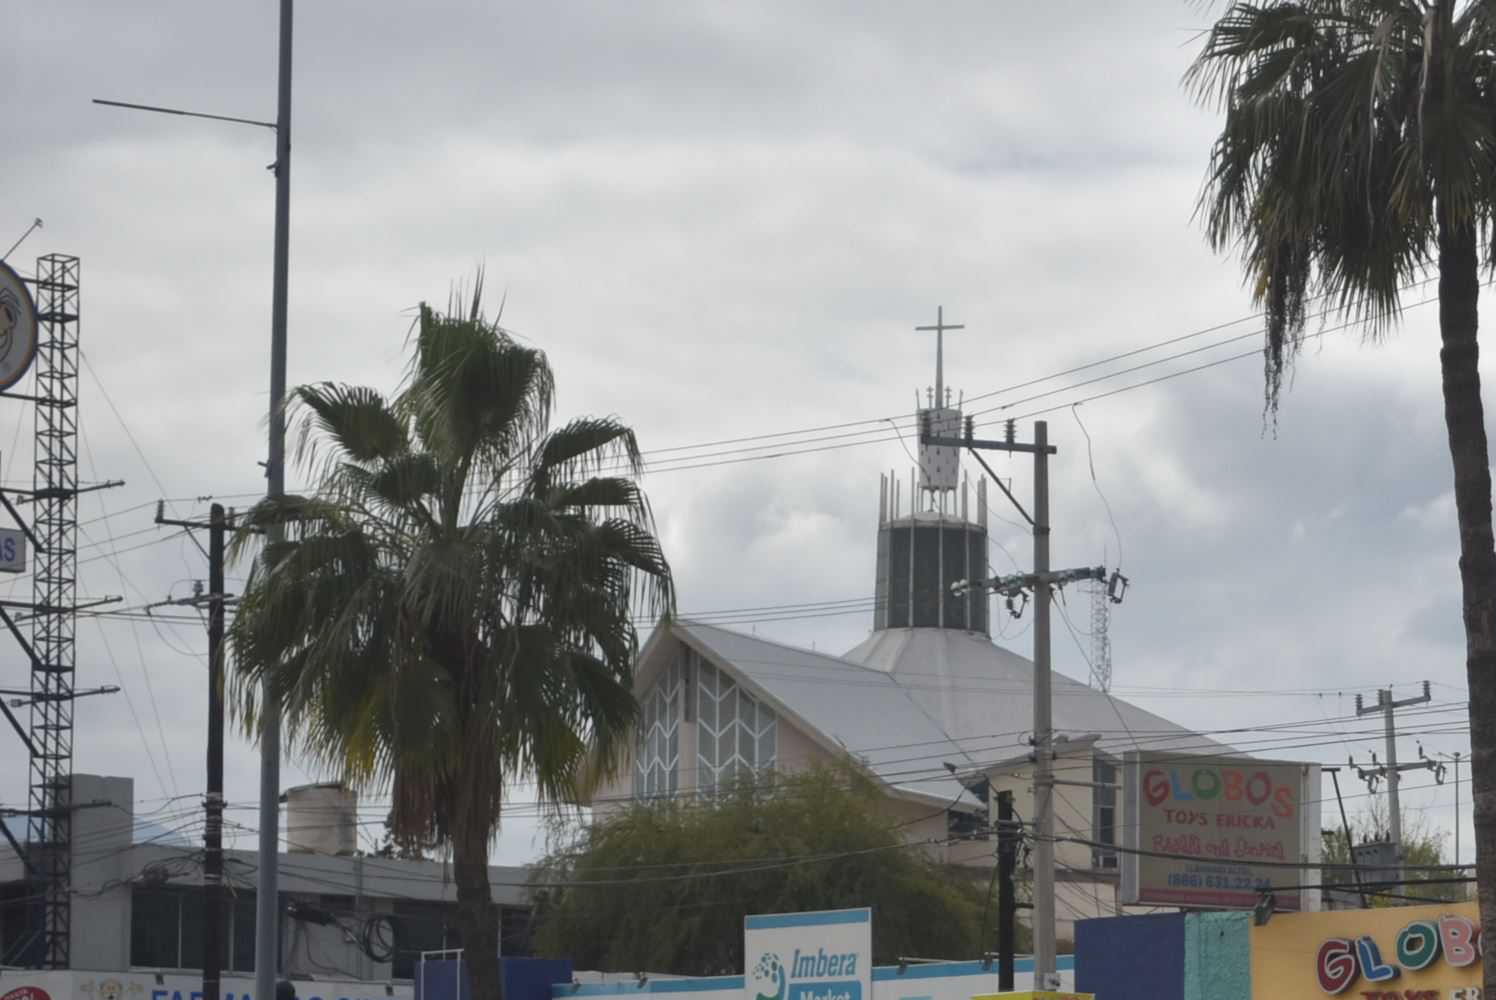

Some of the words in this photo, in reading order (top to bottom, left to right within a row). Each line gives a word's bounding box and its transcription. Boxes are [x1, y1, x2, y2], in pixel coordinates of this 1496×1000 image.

[0, 537, 16, 561] S
[1142, 768, 1298, 818] GLOBOS
[1164, 808, 1208, 827] TOYS
[790, 948, 857, 979] Imbera
